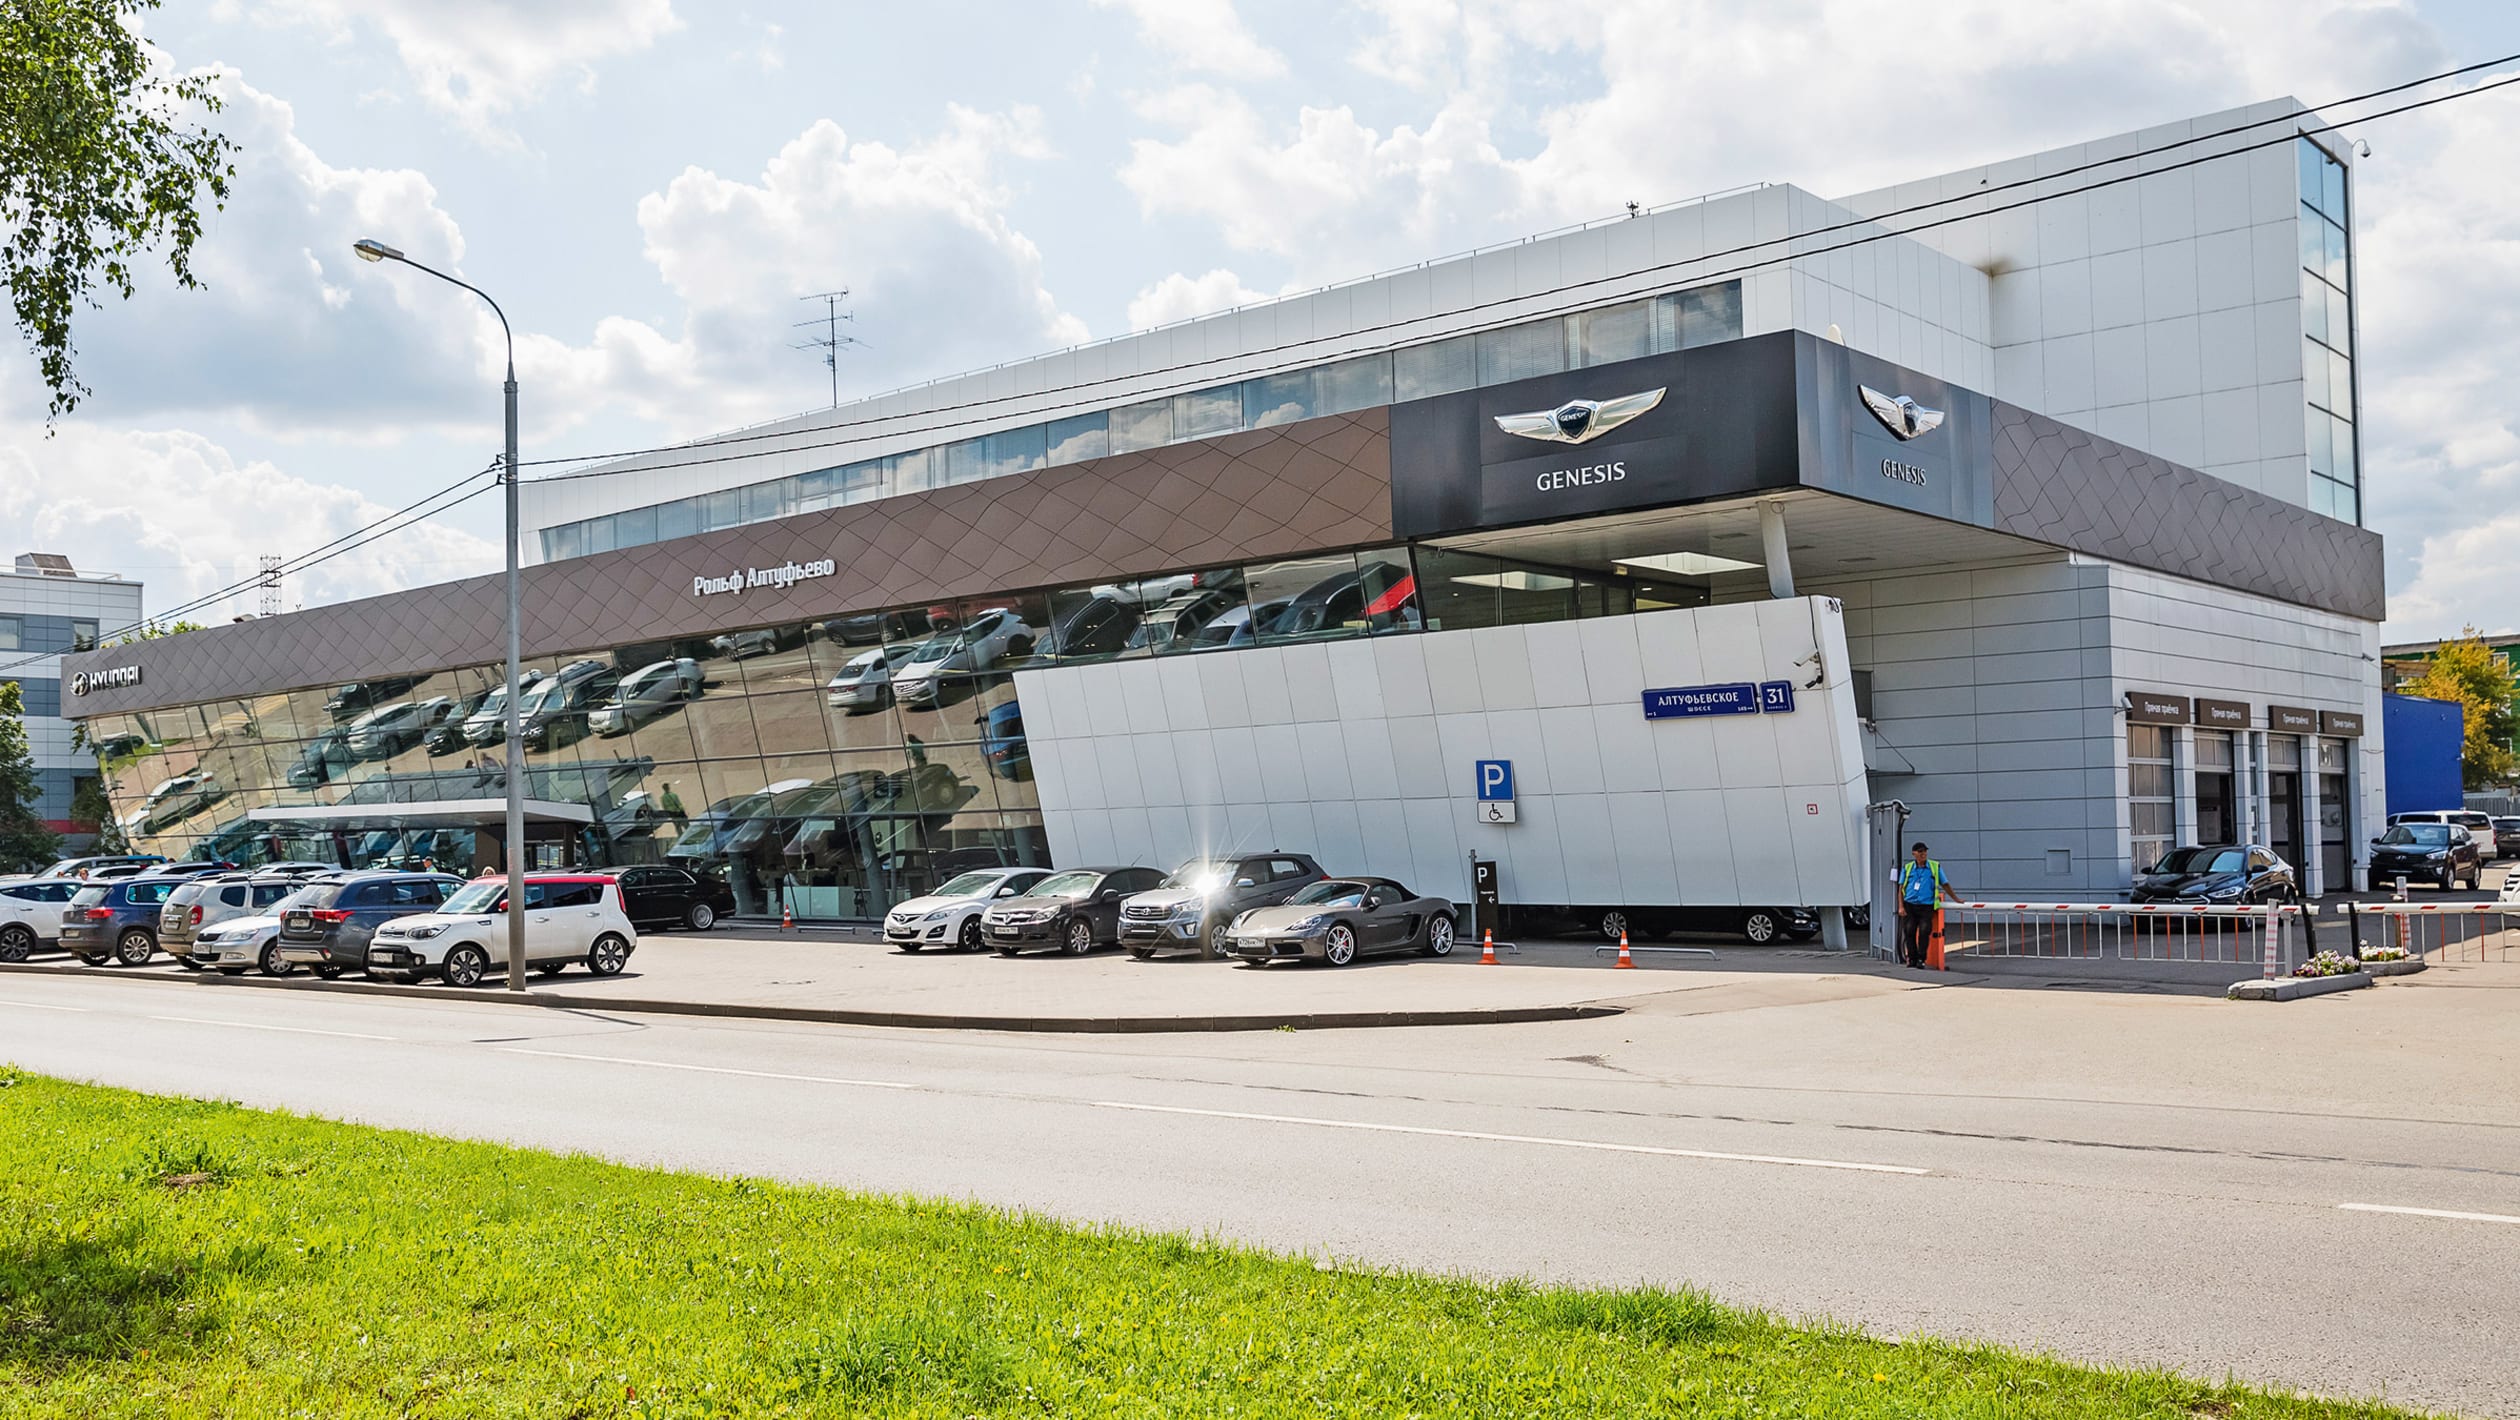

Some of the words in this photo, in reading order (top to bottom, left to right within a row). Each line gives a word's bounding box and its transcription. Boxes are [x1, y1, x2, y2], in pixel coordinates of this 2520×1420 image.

[1536, 462, 1626, 491] GENESIS
[1881, 459, 1926, 486] GENESIS
[694, 570, 745, 596] Рольф
[746, 559, 836, 589] Алтуфьево
[89, 665, 142, 692] HYUNDAI
[1658, 692, 1739, 706] АЛТУФЬЕВСКОЕ
[1766, 687, 1784, 704] 31
[1483, 764, 1504, 796] P
[1477, 867, 1488, 883] P
